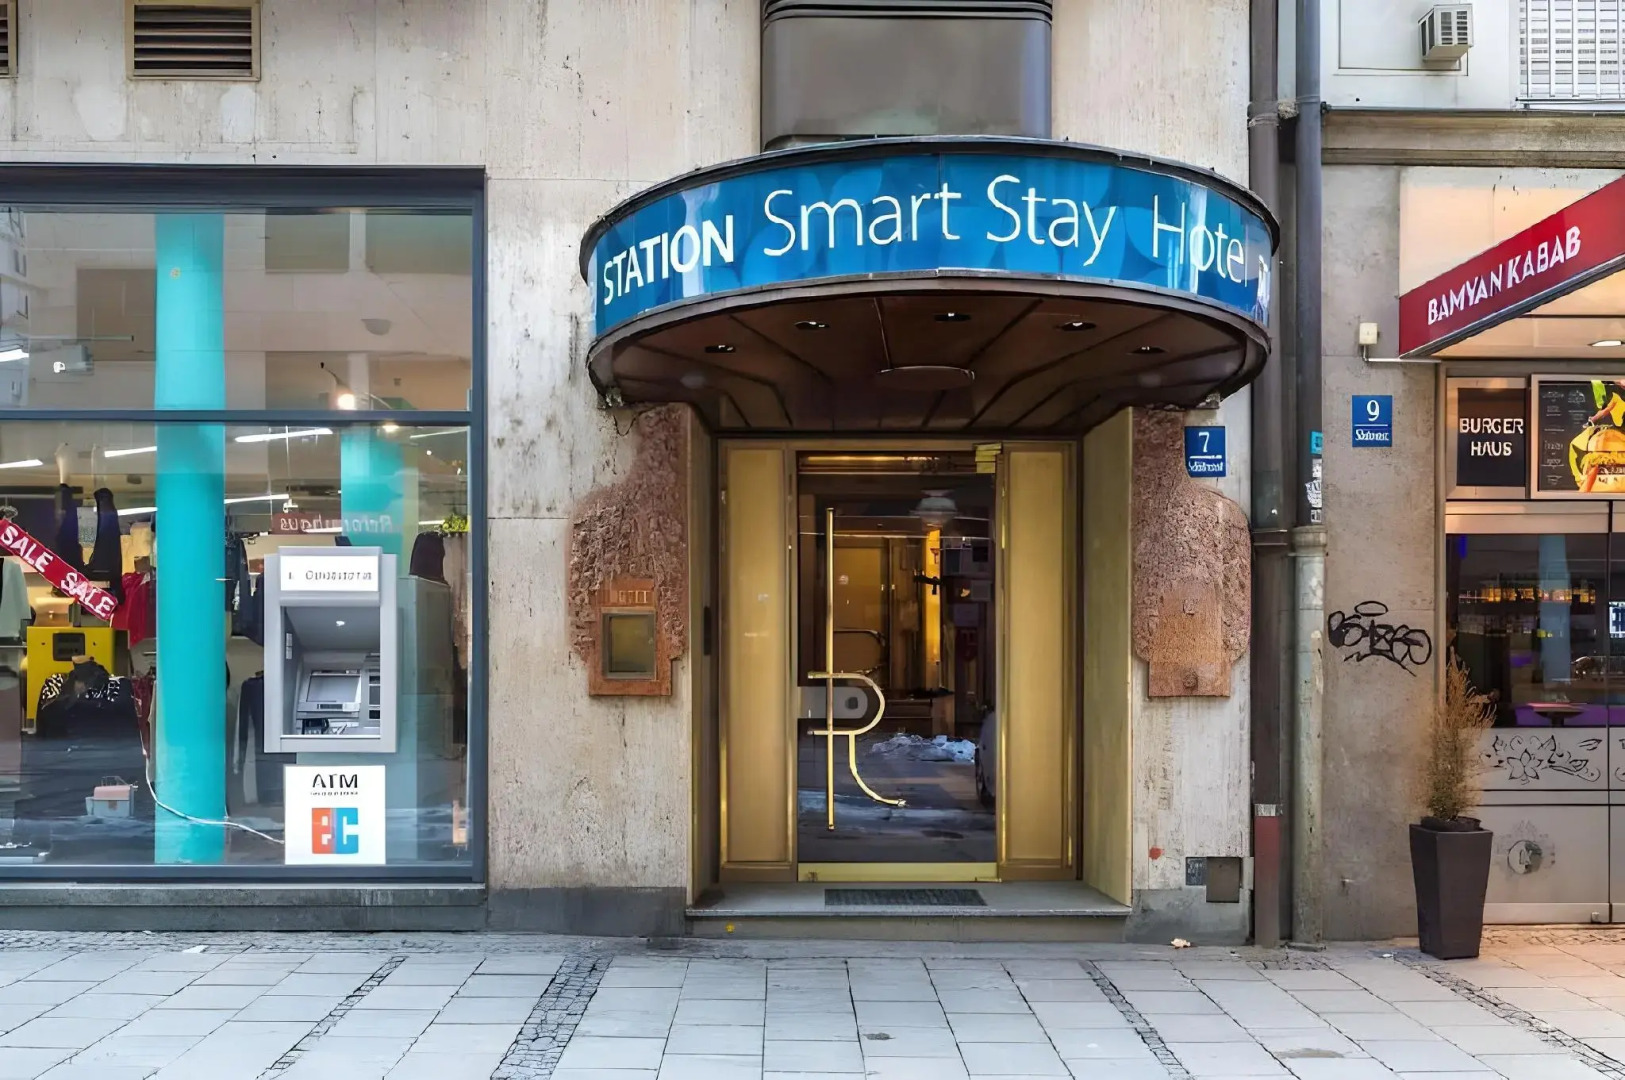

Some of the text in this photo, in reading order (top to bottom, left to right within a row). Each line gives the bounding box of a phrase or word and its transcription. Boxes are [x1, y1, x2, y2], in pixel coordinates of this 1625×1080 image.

[603, 174, 1248, 305] STATION Smart Stay Hotel
[1427, 225, 1581, 326] BAMYAN KABAB
[1366, 399, 1380, 422] 9
[1459, 417, 1524, 434] BURGER
[1198, 431, 1210, 453] 7
[1470, 441, 1513, 457] HAUS
[0, 525, 115, 618] SALE SALE
[312, 773, 359, 789] ATM
